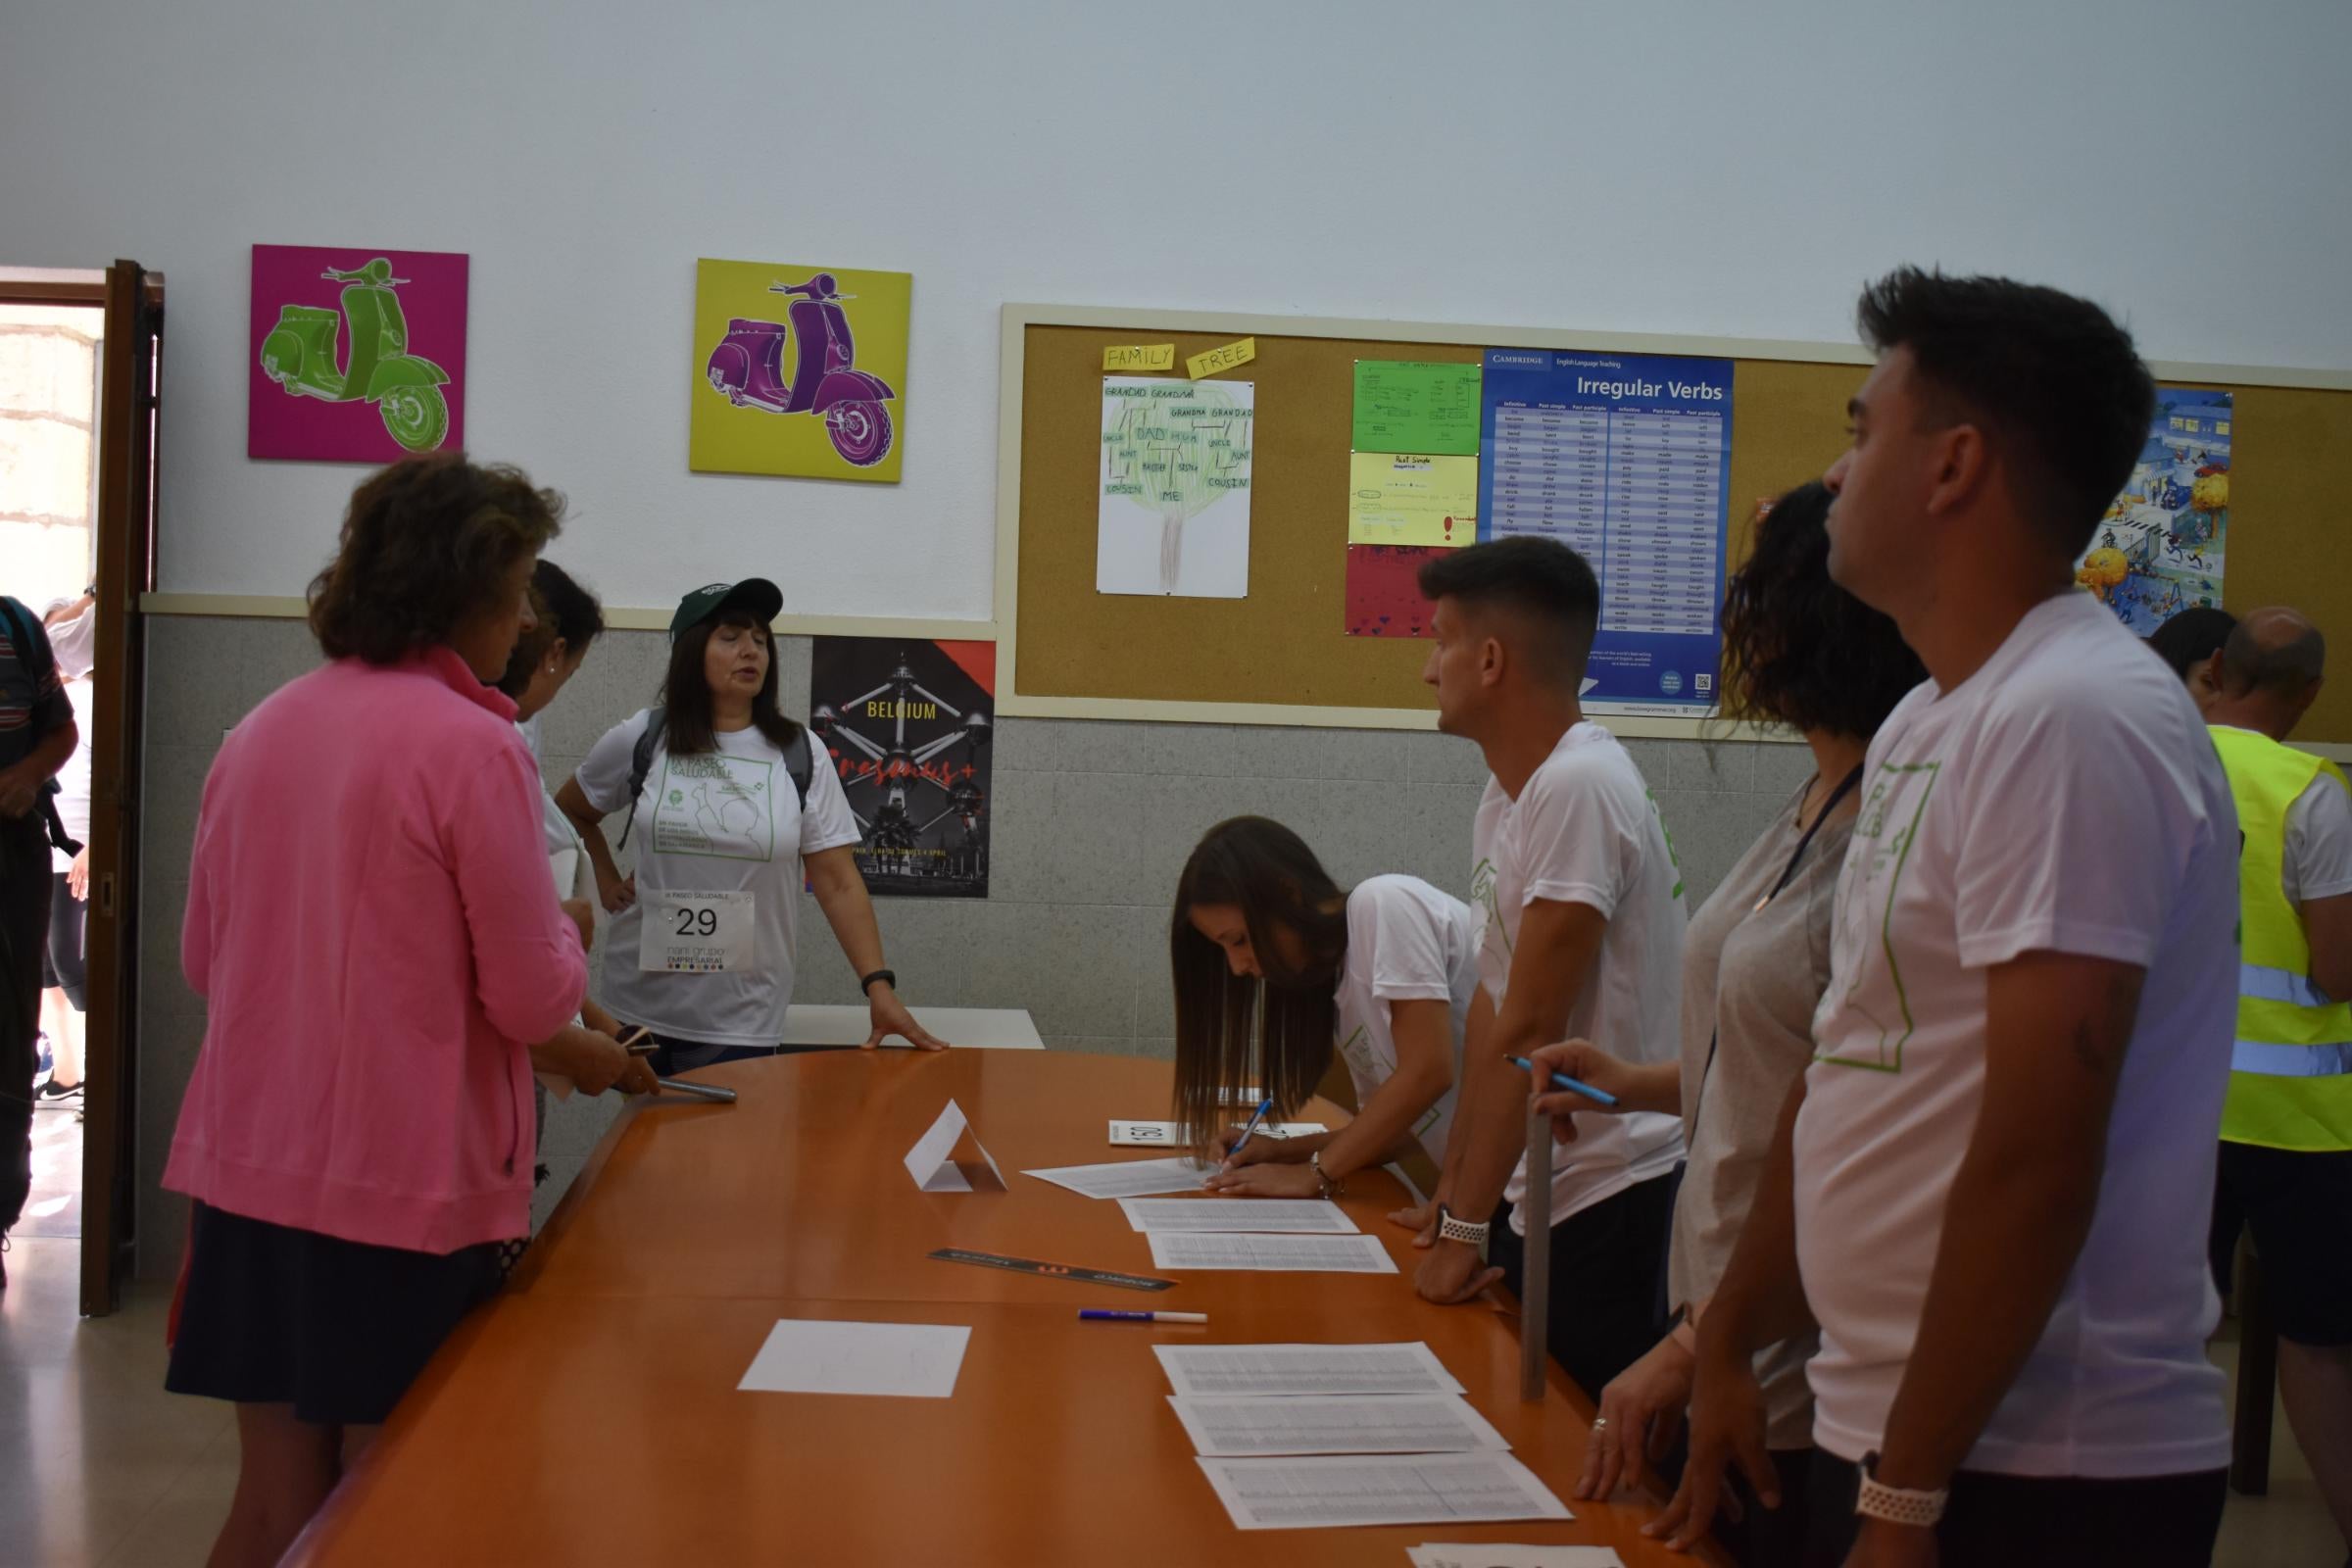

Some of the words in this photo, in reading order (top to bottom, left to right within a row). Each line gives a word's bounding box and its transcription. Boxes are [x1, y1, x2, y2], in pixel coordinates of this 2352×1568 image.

[1107, 348, 1171, 366] FAMILY
[1199, 345, 1248, 374] TREE
[1493, 354, 1544, 365] CAMBRIDGE
[1556, 358, 1574, 368] English
[1575, 359, 1597, 369] Language
[1599, 360, 1621, 369] Teaching
[1577, 376, 1662, 400] Irregular
[1668, 381, 1723, 401] Verbs
[1170, 408, 1206, 417] GRANDMA
[1211, 408, 1252, 417] GRANDAD
[1137, 428, 1165, 440] DAD
[1208, 477, 1248, 488] COUSIN
[1162, 491, 1181, 502] ME
[867, 701, 937, 720] BELGIUM
[689, 757, 727, 769] PASEO
[829, 748, 958, 788] rasmus
[669, 766, 733, 780] SALUDABLE
[676, 907, 717, 937] 29
